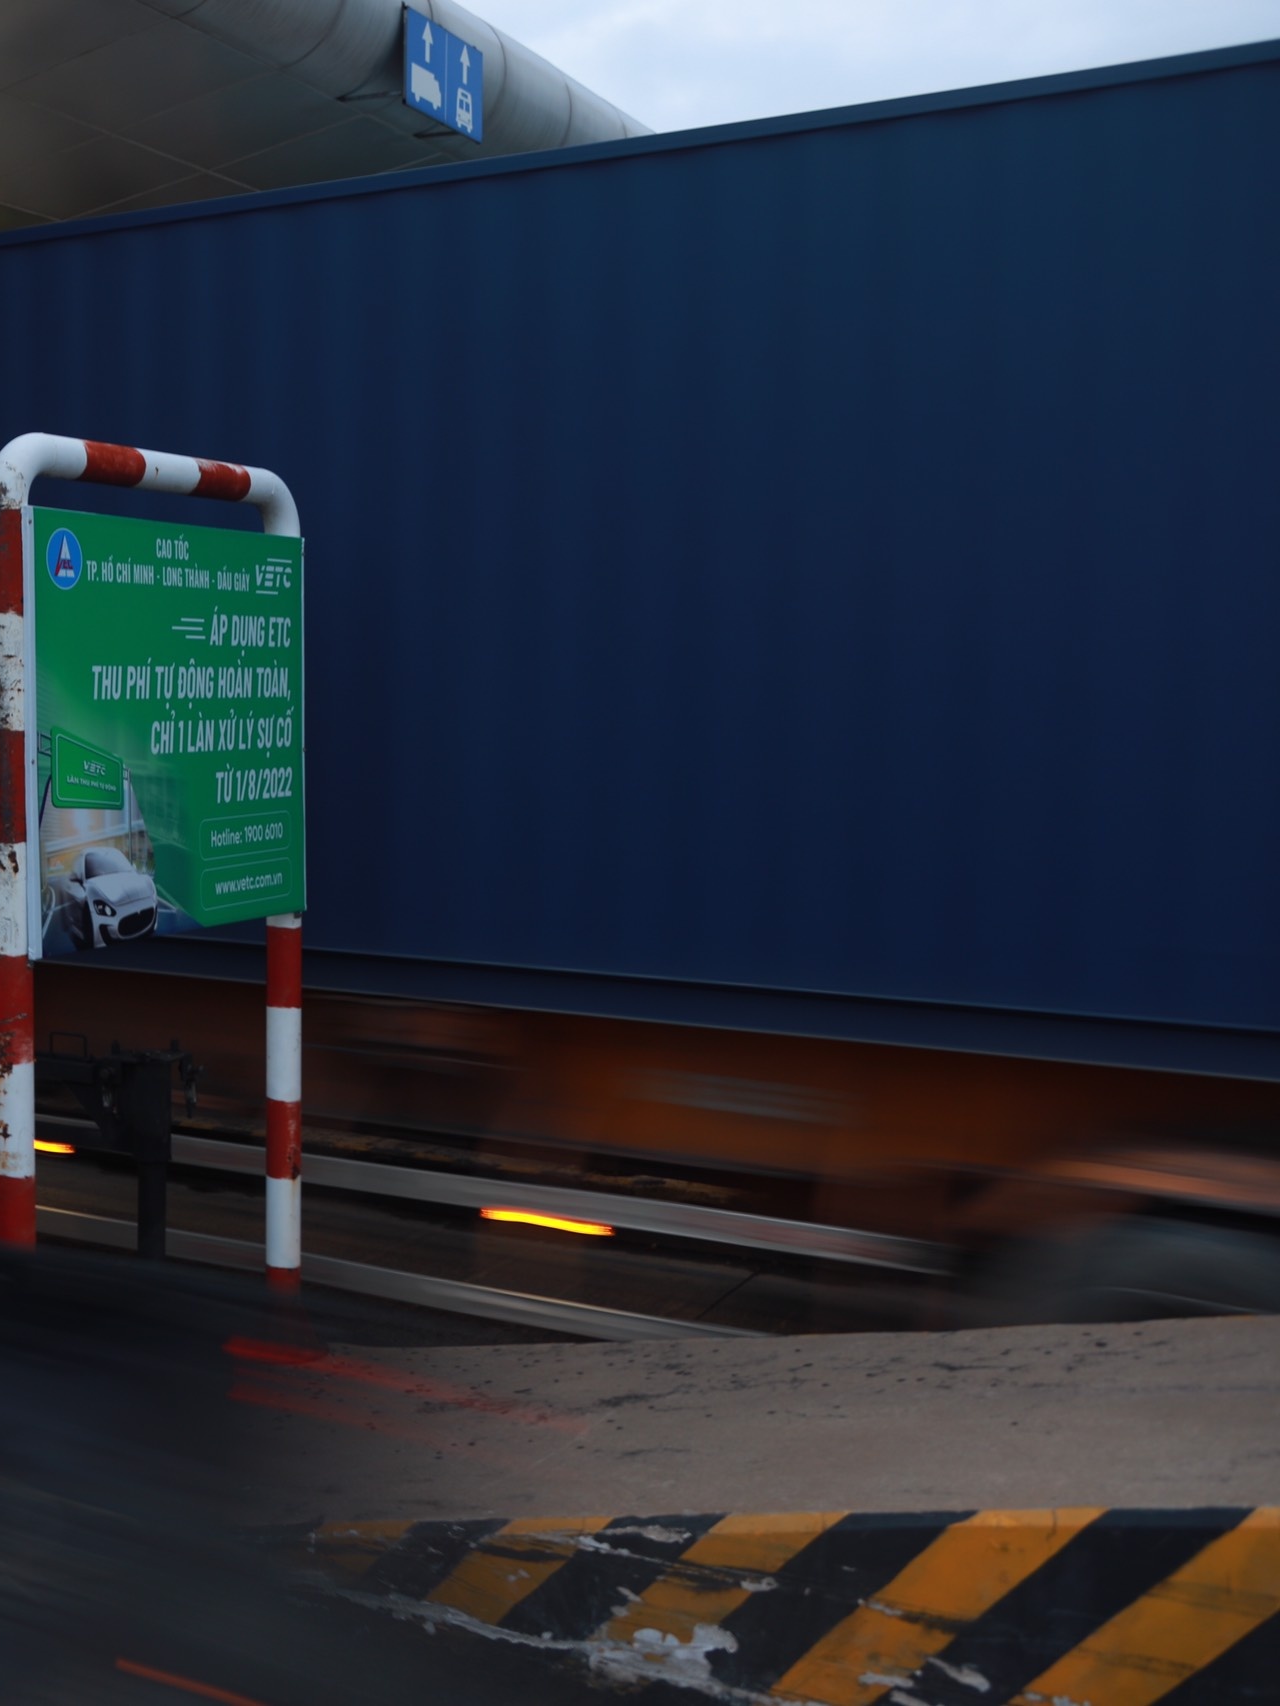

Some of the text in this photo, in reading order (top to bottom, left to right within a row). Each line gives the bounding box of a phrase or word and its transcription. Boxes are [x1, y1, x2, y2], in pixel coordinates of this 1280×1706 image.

[155, 533, 190, 561] CAO TỐC
[86, 559, 99, 582] TP.
[116, 556, 131, 584] CHÍ
[133, 563, 154, 585] MINH
[162, 566, 183, 588] LONG
[184, 562, 210, 590] THÀNH
[255, 564, 293, 589] VETC
[209, 605, 292, 657] ÁP DỤNG ETC
[91, 657, 292, 710] THU PHÍ TỰ ĐỘNG HOÀN TOÀN,
[151, 706, 295, 759] CHỈ 1 LÀN XỬ LÝ SỰ CỐ
[216, 762, 293, 804] TỪ 1/8/2022
[210, 821, 283, 848] Hotline: 1900 6010
[215, 872, 283, 896] www.vetc.com.vn
